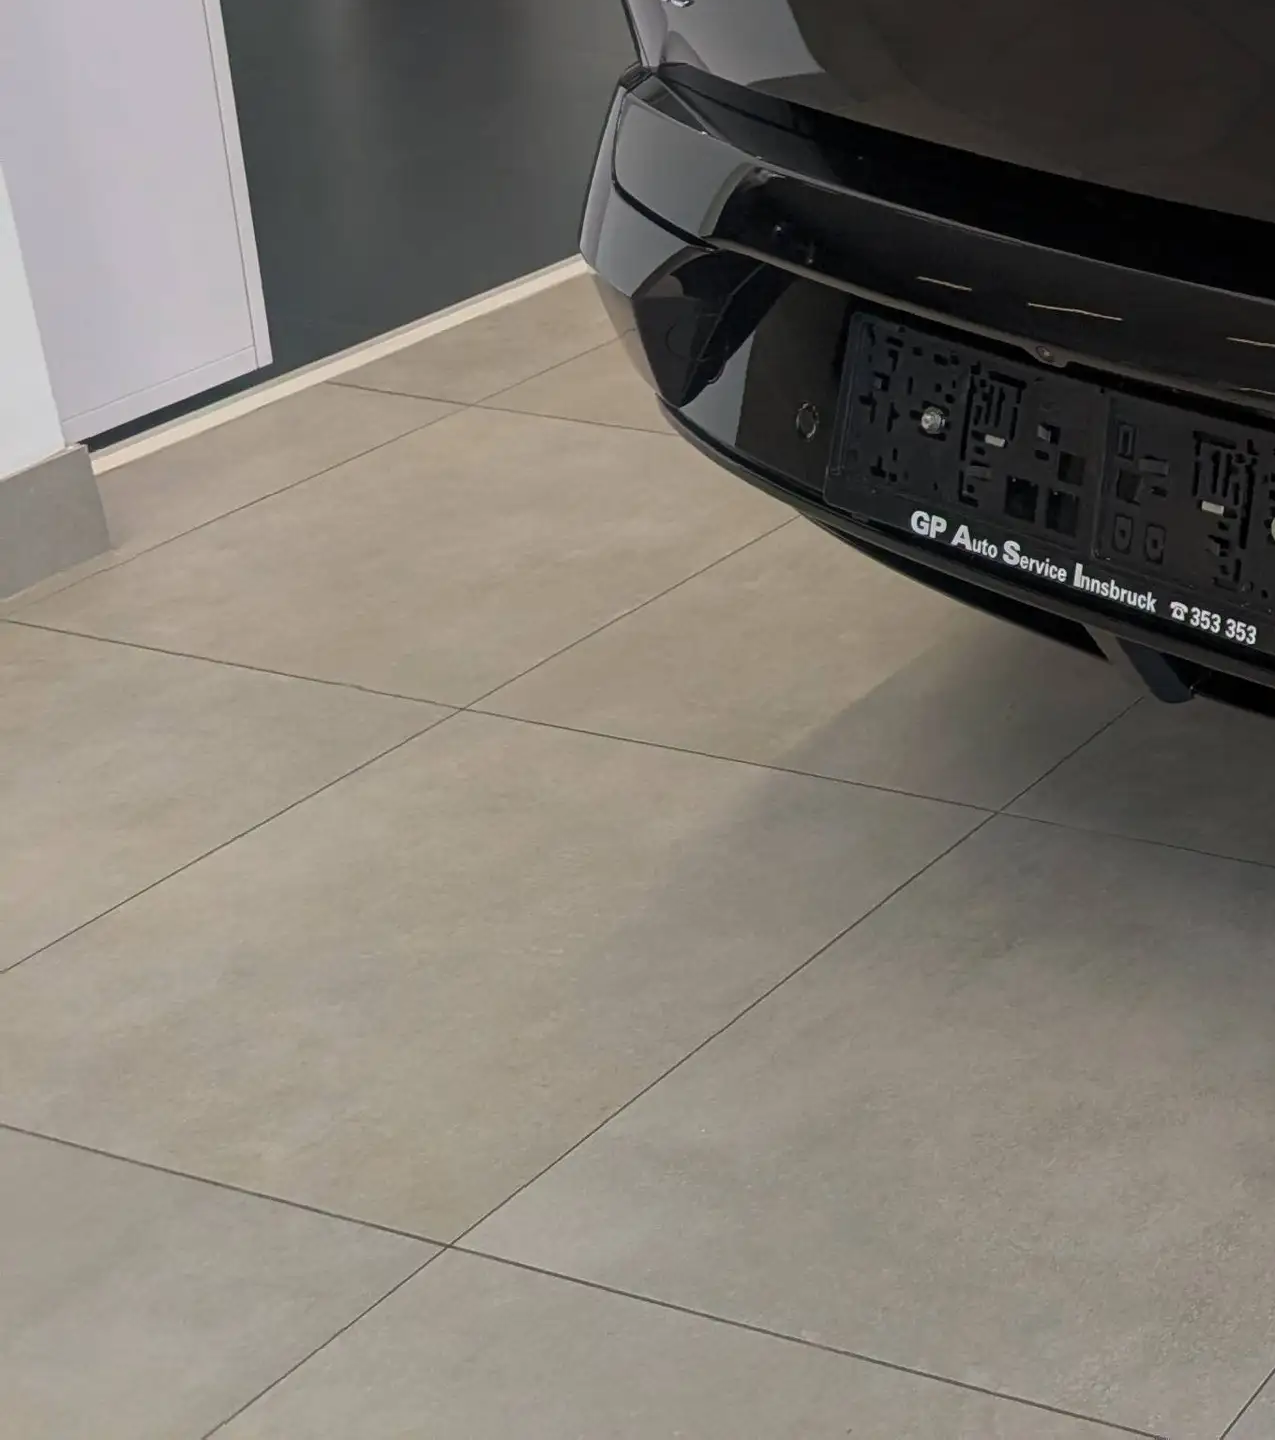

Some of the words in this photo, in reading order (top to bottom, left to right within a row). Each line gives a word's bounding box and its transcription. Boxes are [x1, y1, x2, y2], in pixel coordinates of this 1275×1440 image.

[910, 510, 947, 539] GP
[951, 524, 998, 558] Auto
[1002, 540, 1068, 582] Service
[1073, 563, 1158, 613] Innsbruck
[1190, 607, 1221, 633] 353
[1225, 619, 1257, 645] 353
